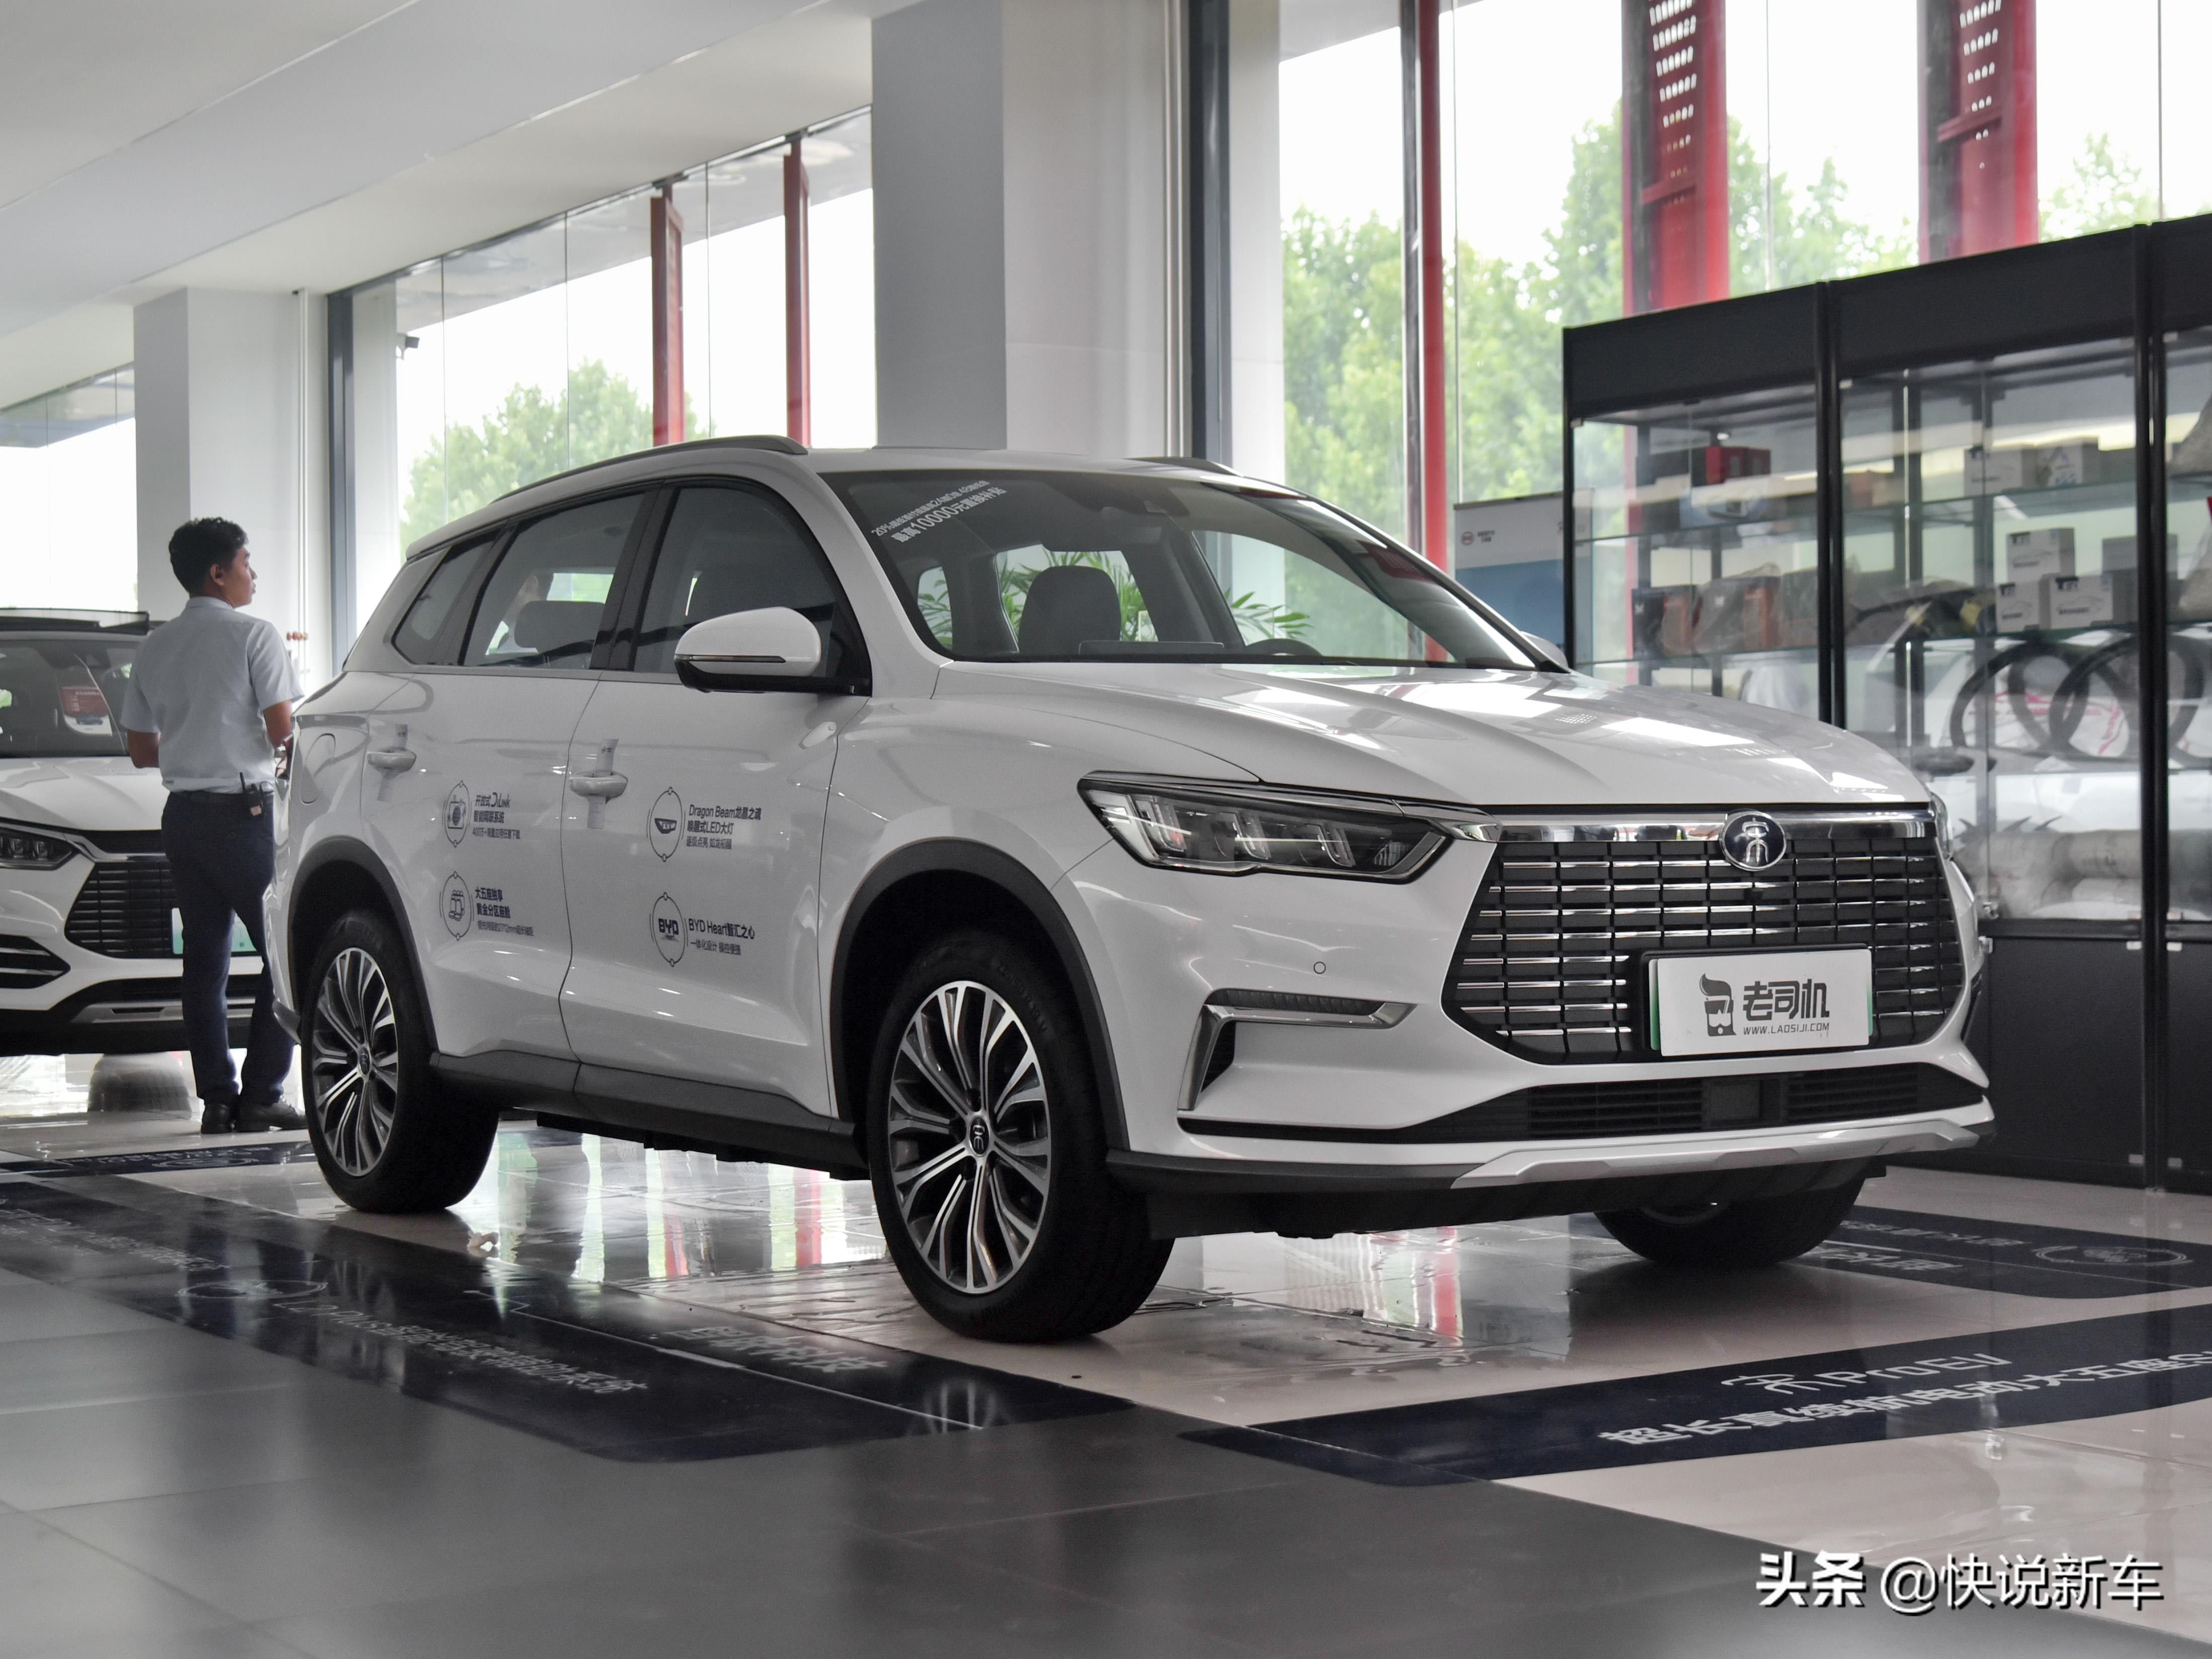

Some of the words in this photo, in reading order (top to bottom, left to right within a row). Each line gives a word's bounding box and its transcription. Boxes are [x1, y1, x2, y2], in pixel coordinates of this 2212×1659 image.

[689, 804, 714, 818] Dragon
[659, 918, 679, 936] BYD
[688, 918, 706, 933] BYD
[1742, 978, 1830, 1021] 老司机
[1743, 1023, 1830, 1036] WWW.LAOSIJI.COM
[1597, 1351, 2212, 1444] 超长真续航电动大五座S
